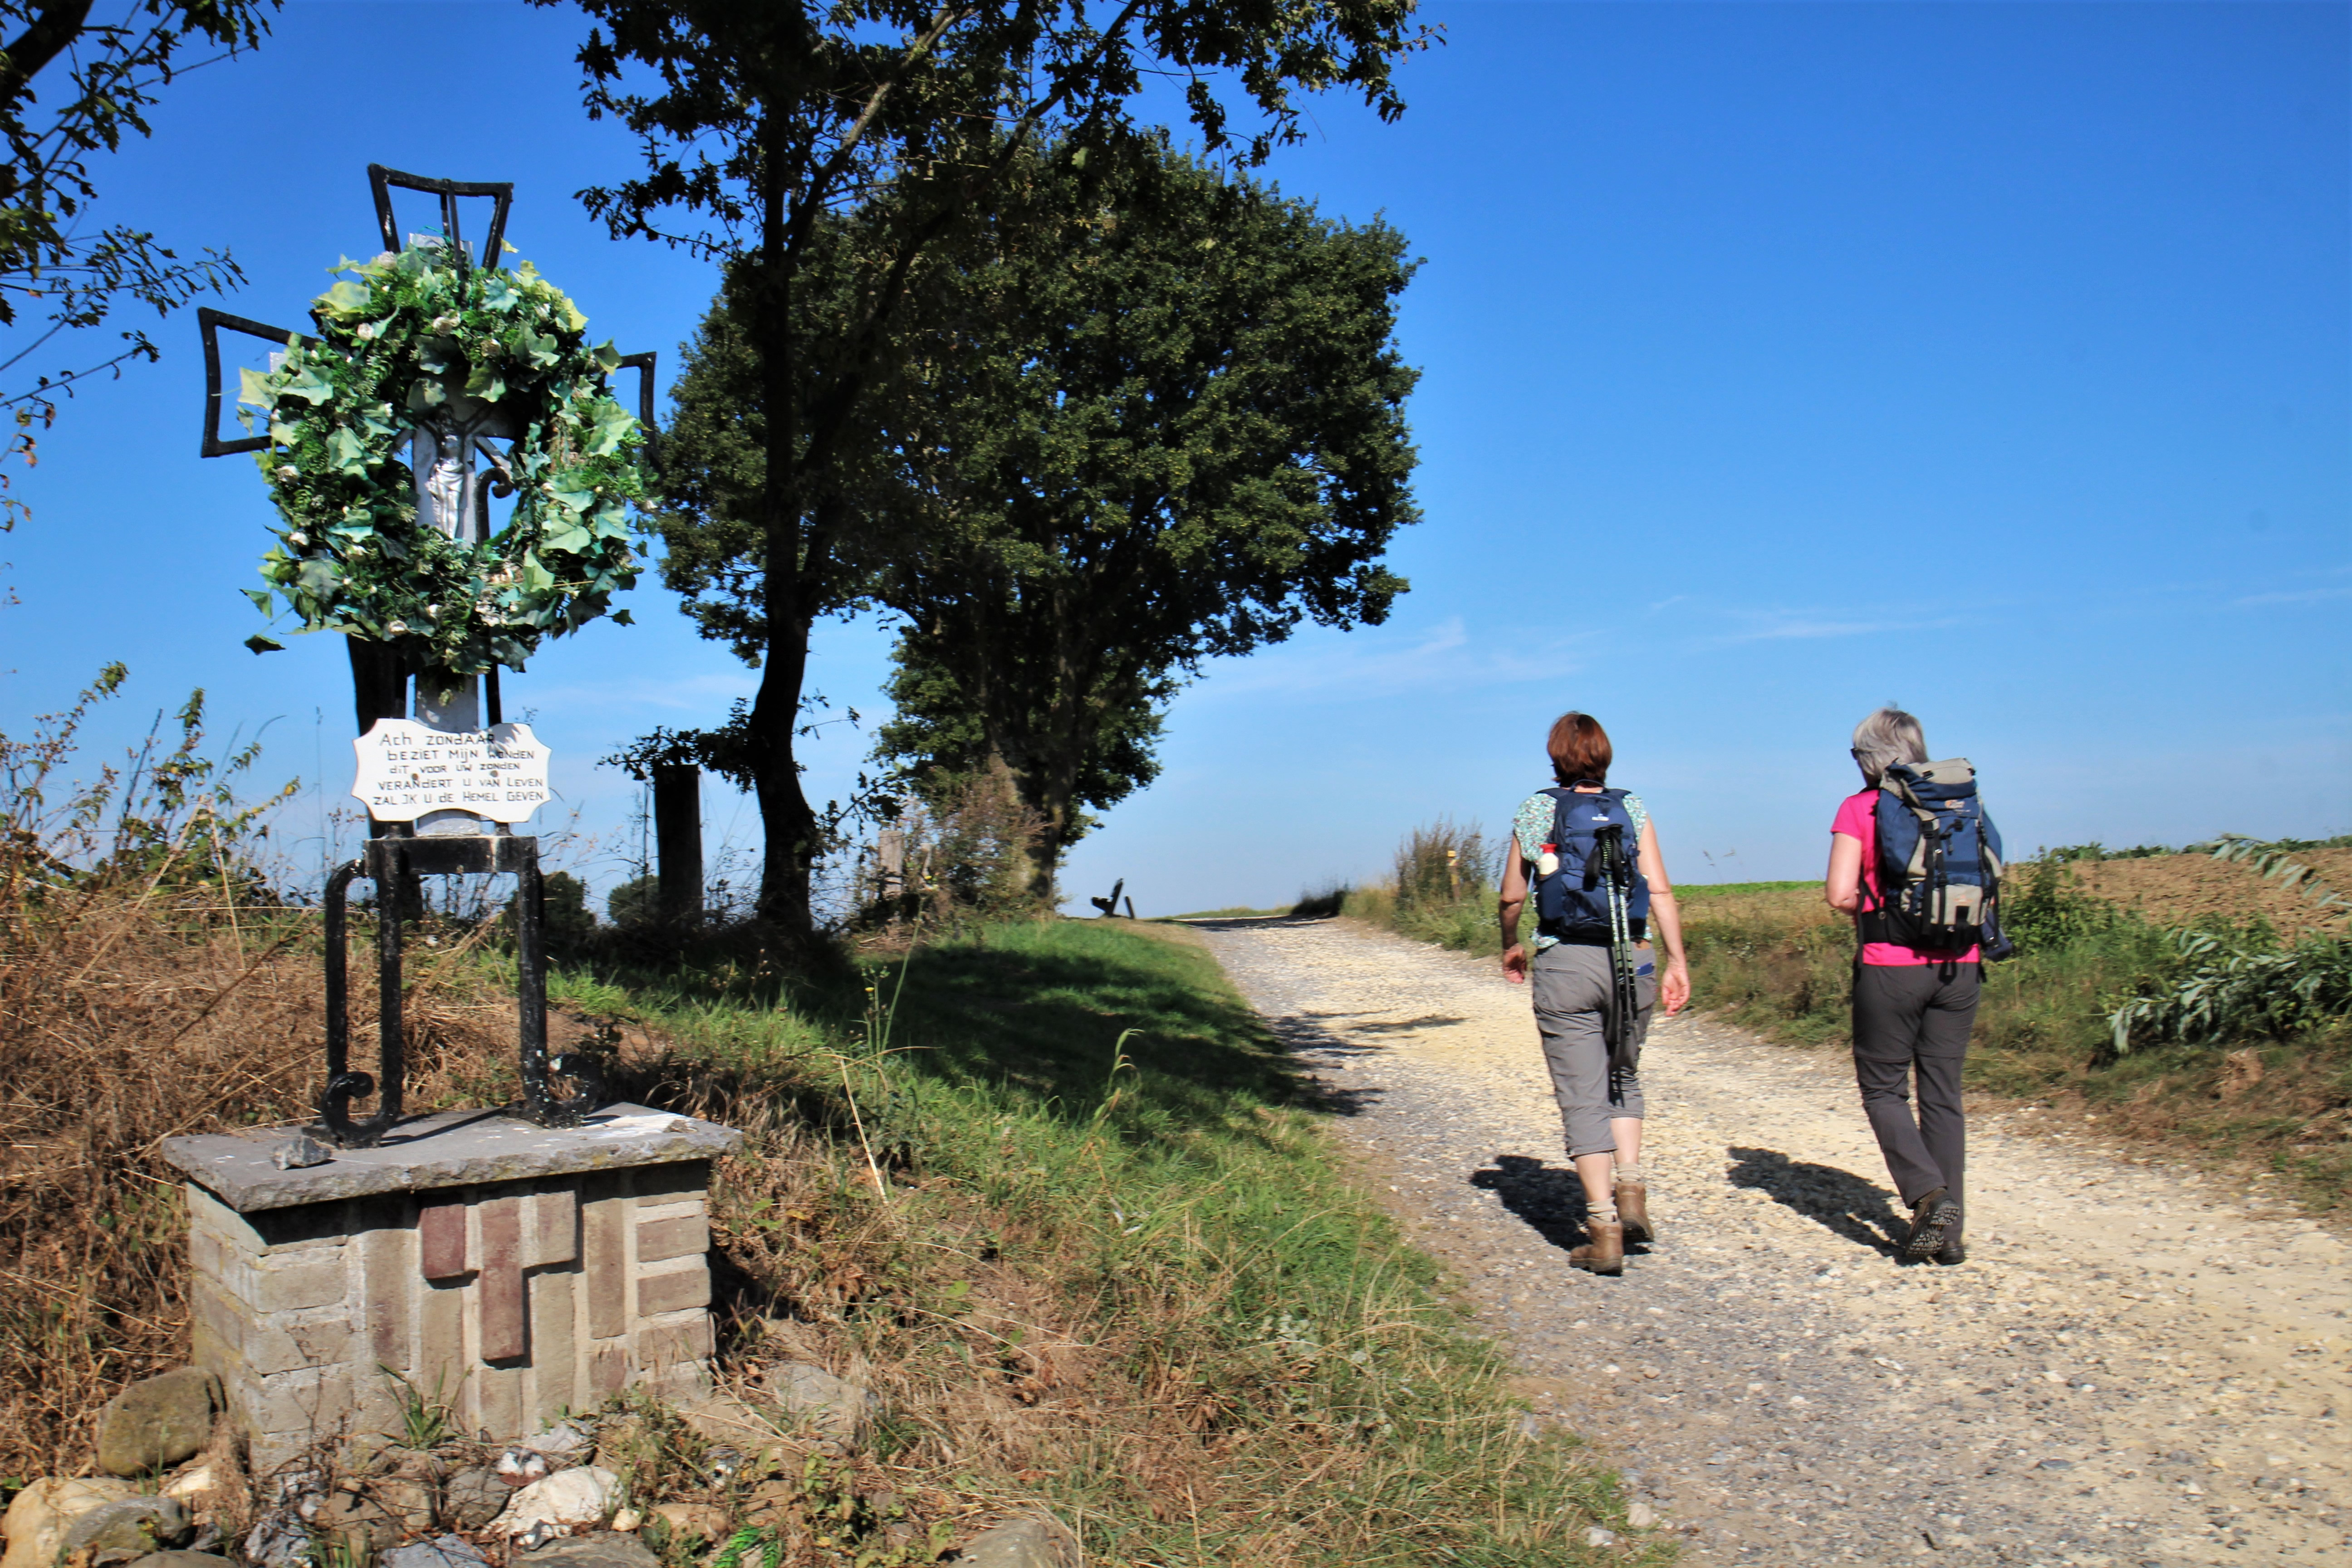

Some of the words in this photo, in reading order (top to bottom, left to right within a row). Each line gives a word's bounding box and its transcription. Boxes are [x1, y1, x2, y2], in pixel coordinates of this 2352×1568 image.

[379, 731, 412, 746] Ach
[419, 765, 447, 773] VOOR
[479, 779, 501, 788] VAN
[507, 777, 543, 787] LEVEN
[373, 796, 399, 805] ZAL
[424, 793, 432, 804] U
[463, 791, 500, 802] HEMEL
[507, 791, 544, 802] GEVEN
